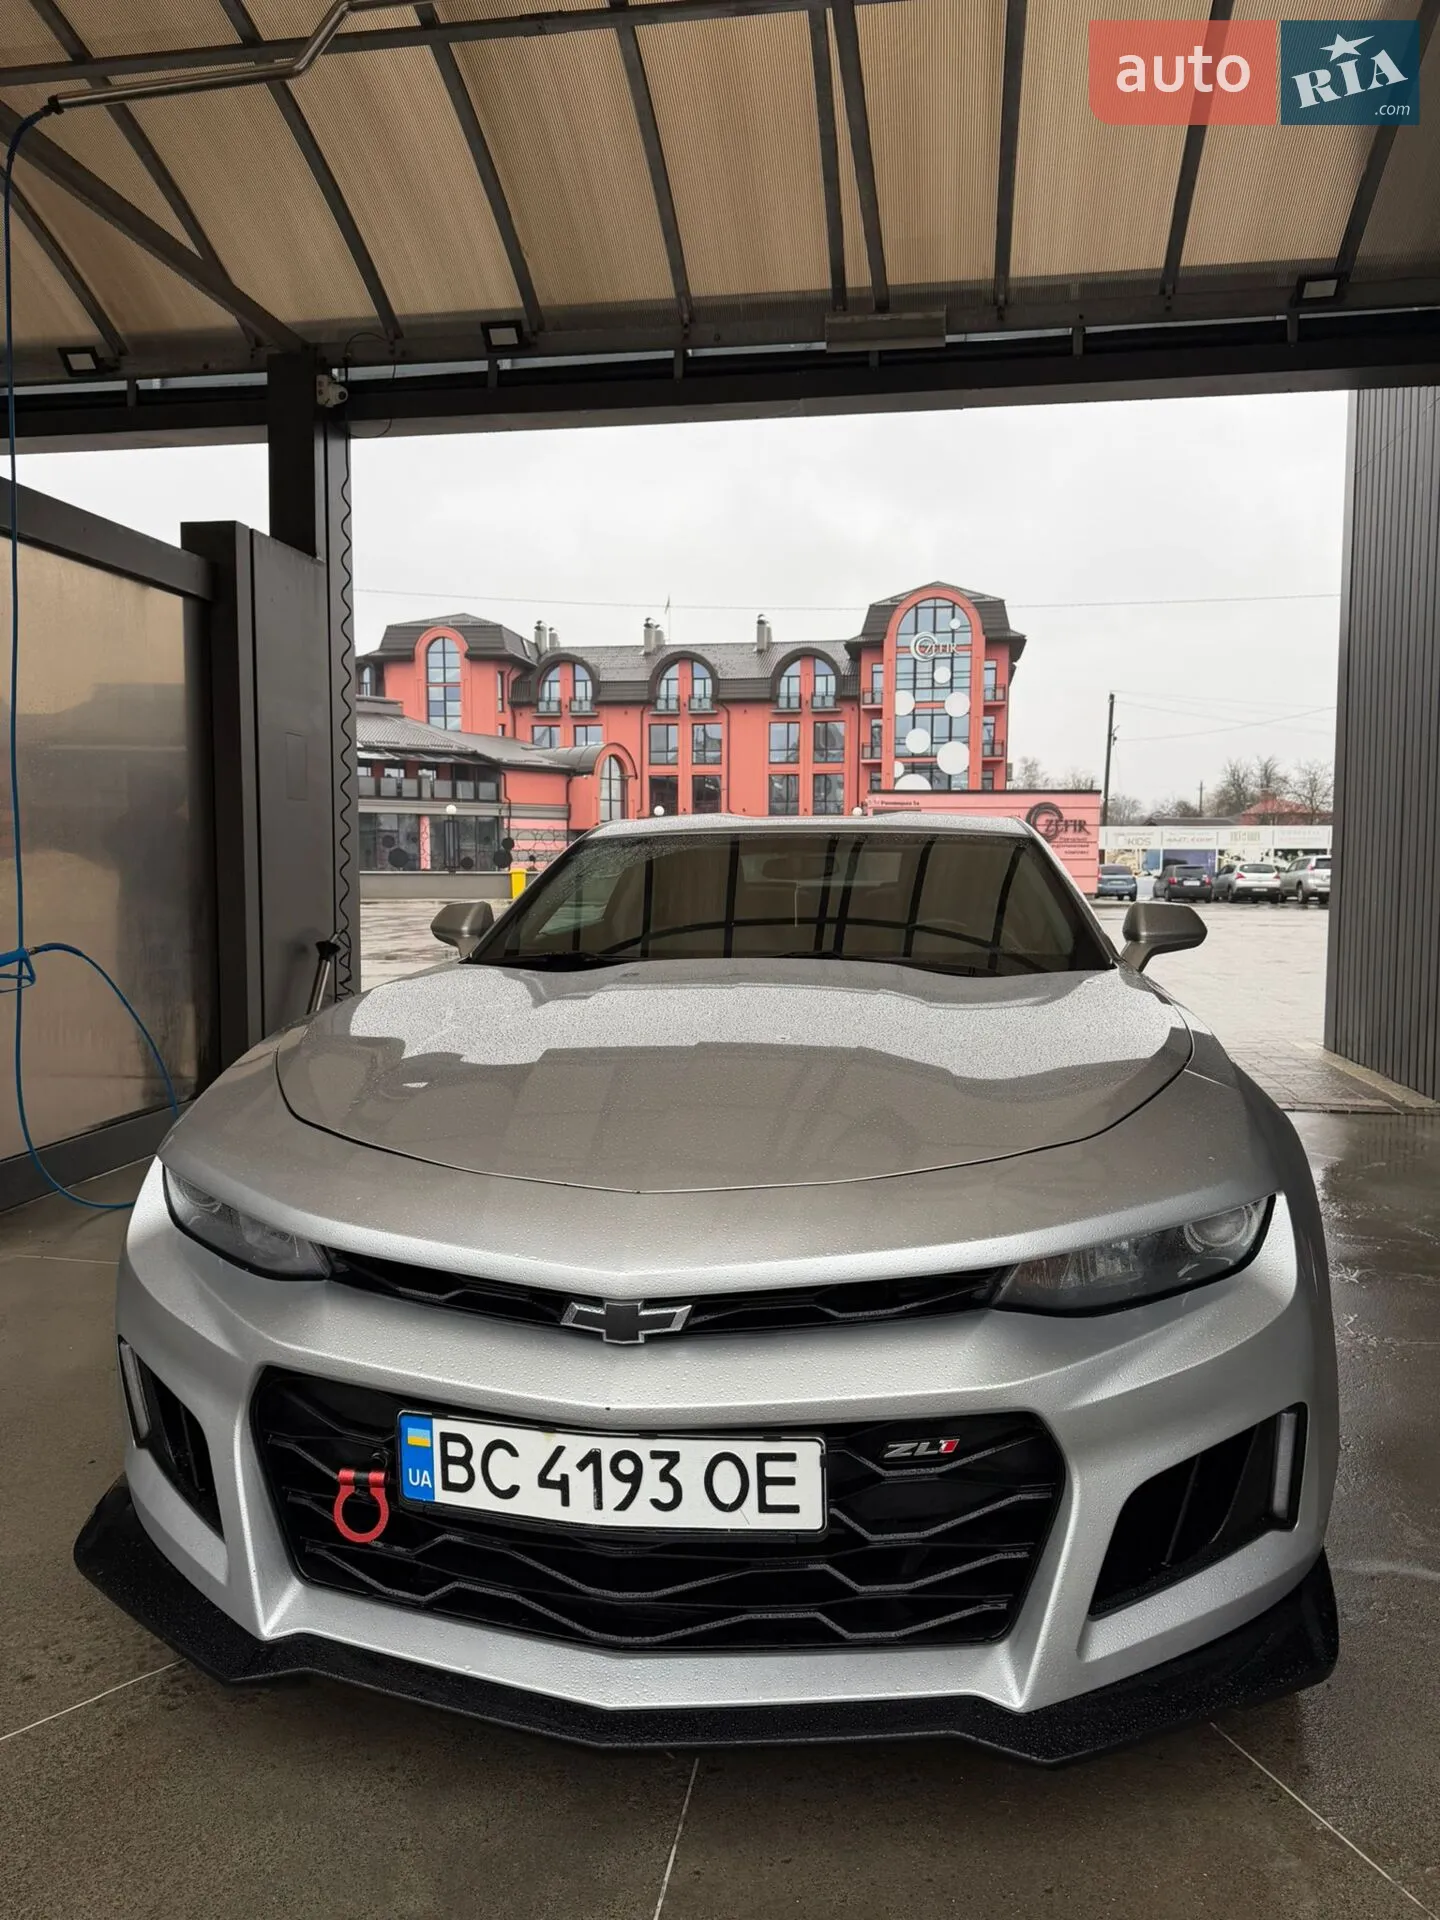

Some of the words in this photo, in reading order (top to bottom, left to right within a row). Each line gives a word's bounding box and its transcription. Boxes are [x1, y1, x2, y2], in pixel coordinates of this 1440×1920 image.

[883, 1438, 960, 1459] ZL1
[408, 1467, 432, 1488] UA
[439, 1431, 520, 1500] BC
[537, 1444, 684, 1513] 4193
[703, 1451, 801, 1514] OE
